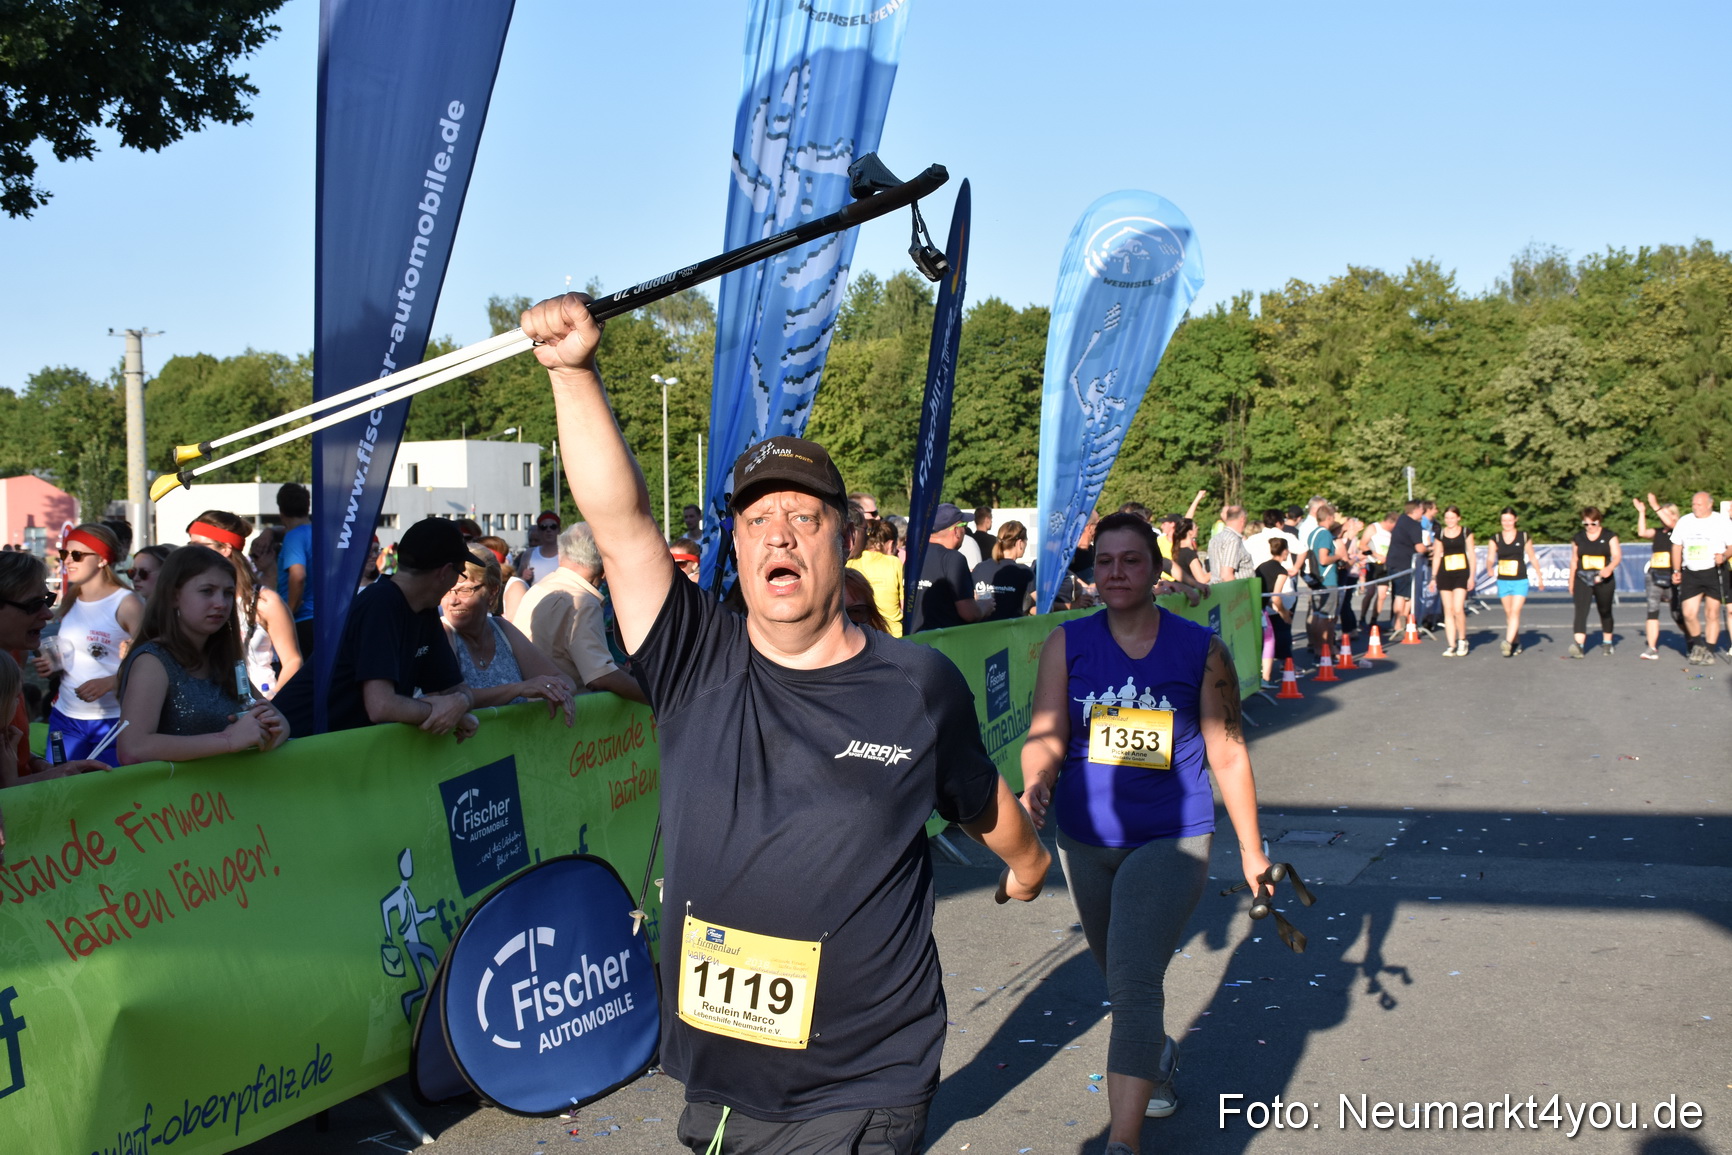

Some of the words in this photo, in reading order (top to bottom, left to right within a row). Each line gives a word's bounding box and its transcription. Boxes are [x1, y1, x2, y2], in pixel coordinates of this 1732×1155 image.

[797, 0, 905, 27] WECHSELSZEN
[1102, 259, 1184, 289] WECHSELSZENE
[569, 713, 645, 778] Gesunde
[834, 740, 893, 760] JURA
[1101, 726, 1160, 752] 1353
[1131, 750, 1148, 758] Anne
[608, 761, 658, 812] laufen
[463, 797, 510, 833] Fischer
[469, 817, 509, 843] AUTOMOBILE
[0, 819, 117, 905] sunde
[114, 792, 235, 853] Firmen
[47, 884, 175, 961] laufen
[169, 824, 280, 912] länger!
[697, 937, 742, 956] firmenlauf
[511, 949, 630, 1031] Fischer
[693, 961, 794, 1015] 1119
[539, 992, 635, 1054] AUTOMOBILE
[694, 1009, 731, 1025] Lebenshilfe
[733, 1020, 767, 1033] Neumarkt
[702, 1001, 739, 1018] Reulein
[743, 1010, 775, 1026] Marco
